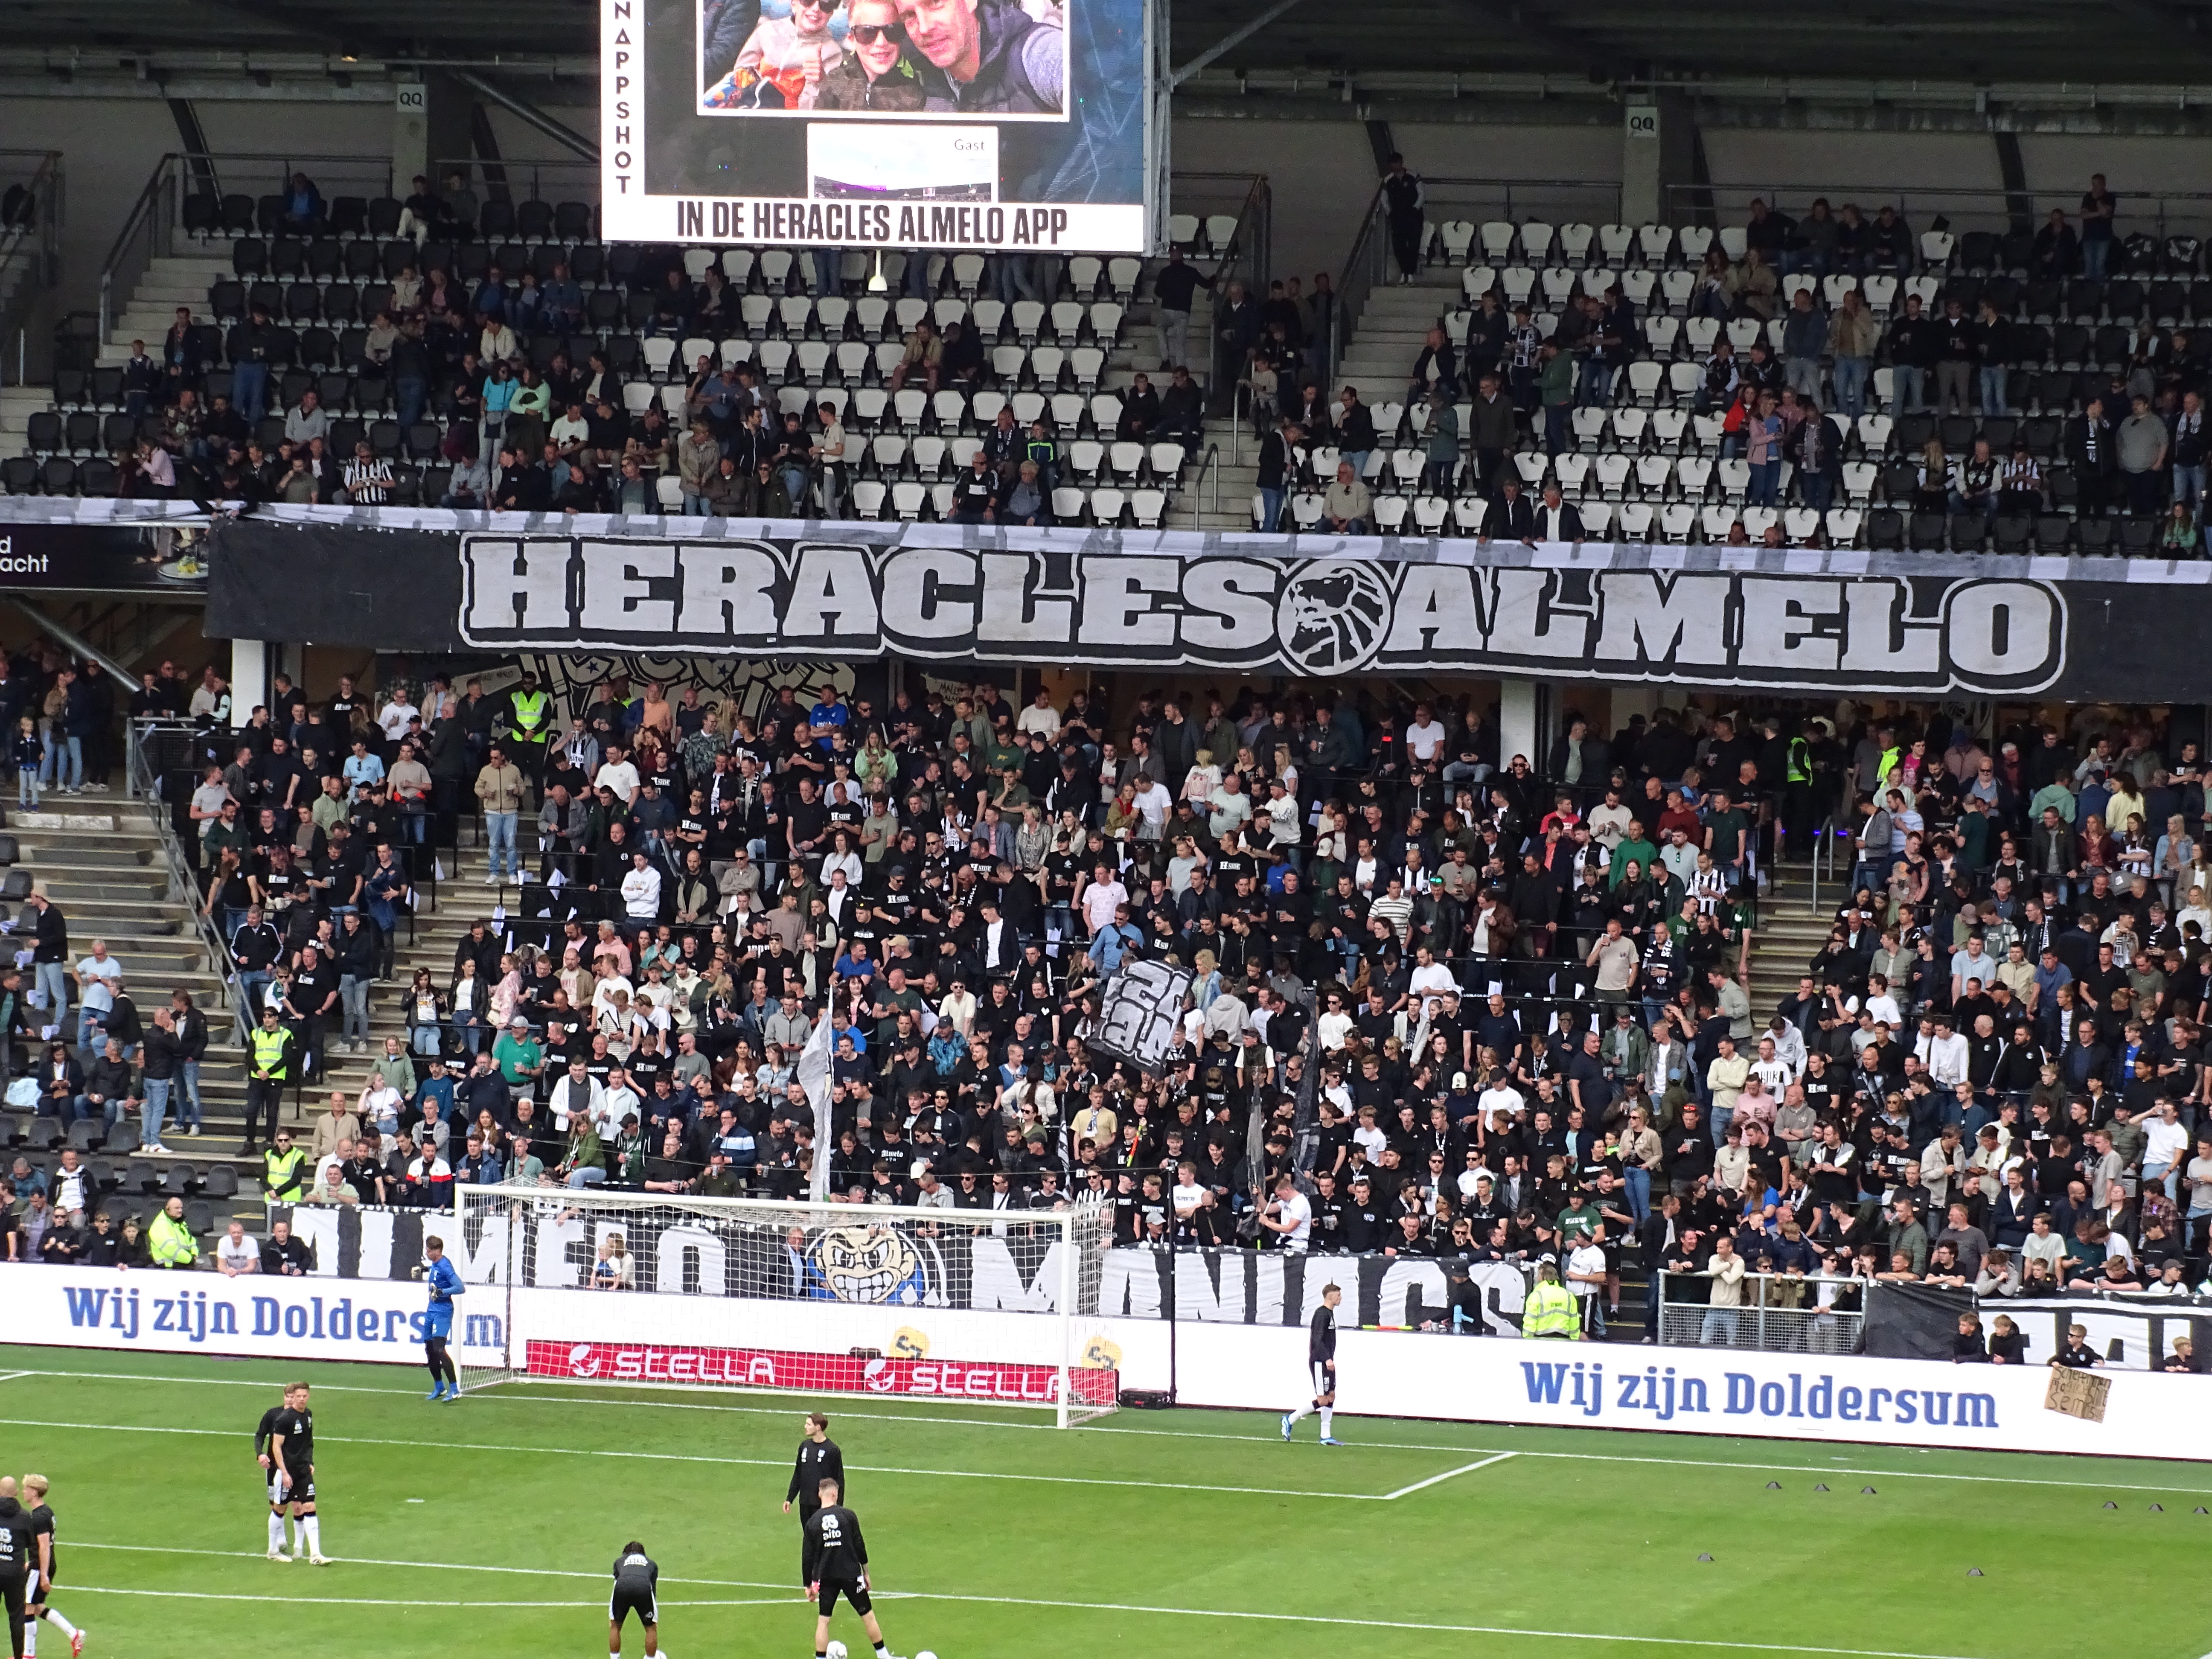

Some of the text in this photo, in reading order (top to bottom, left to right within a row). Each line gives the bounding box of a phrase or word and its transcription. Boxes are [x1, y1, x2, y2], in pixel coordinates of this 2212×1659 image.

[954, 139, 985, 151] Gast
[678, 201, 1067, 244] IN DE HERACLES ALMELO APP
[469, 540, 2052, 678] HERACLES ALMELO
[681, 819, 690, 829] H
[1220, 861, 1228, 870] H
[887, 894, 896, 903] H
[881, 1149, 904, 1158] Almelo
[63, 1287, 512, 1352] Wij zijn Doldersm
[1521, 1362, 2000, 1429] Wij zijn Doldersum
